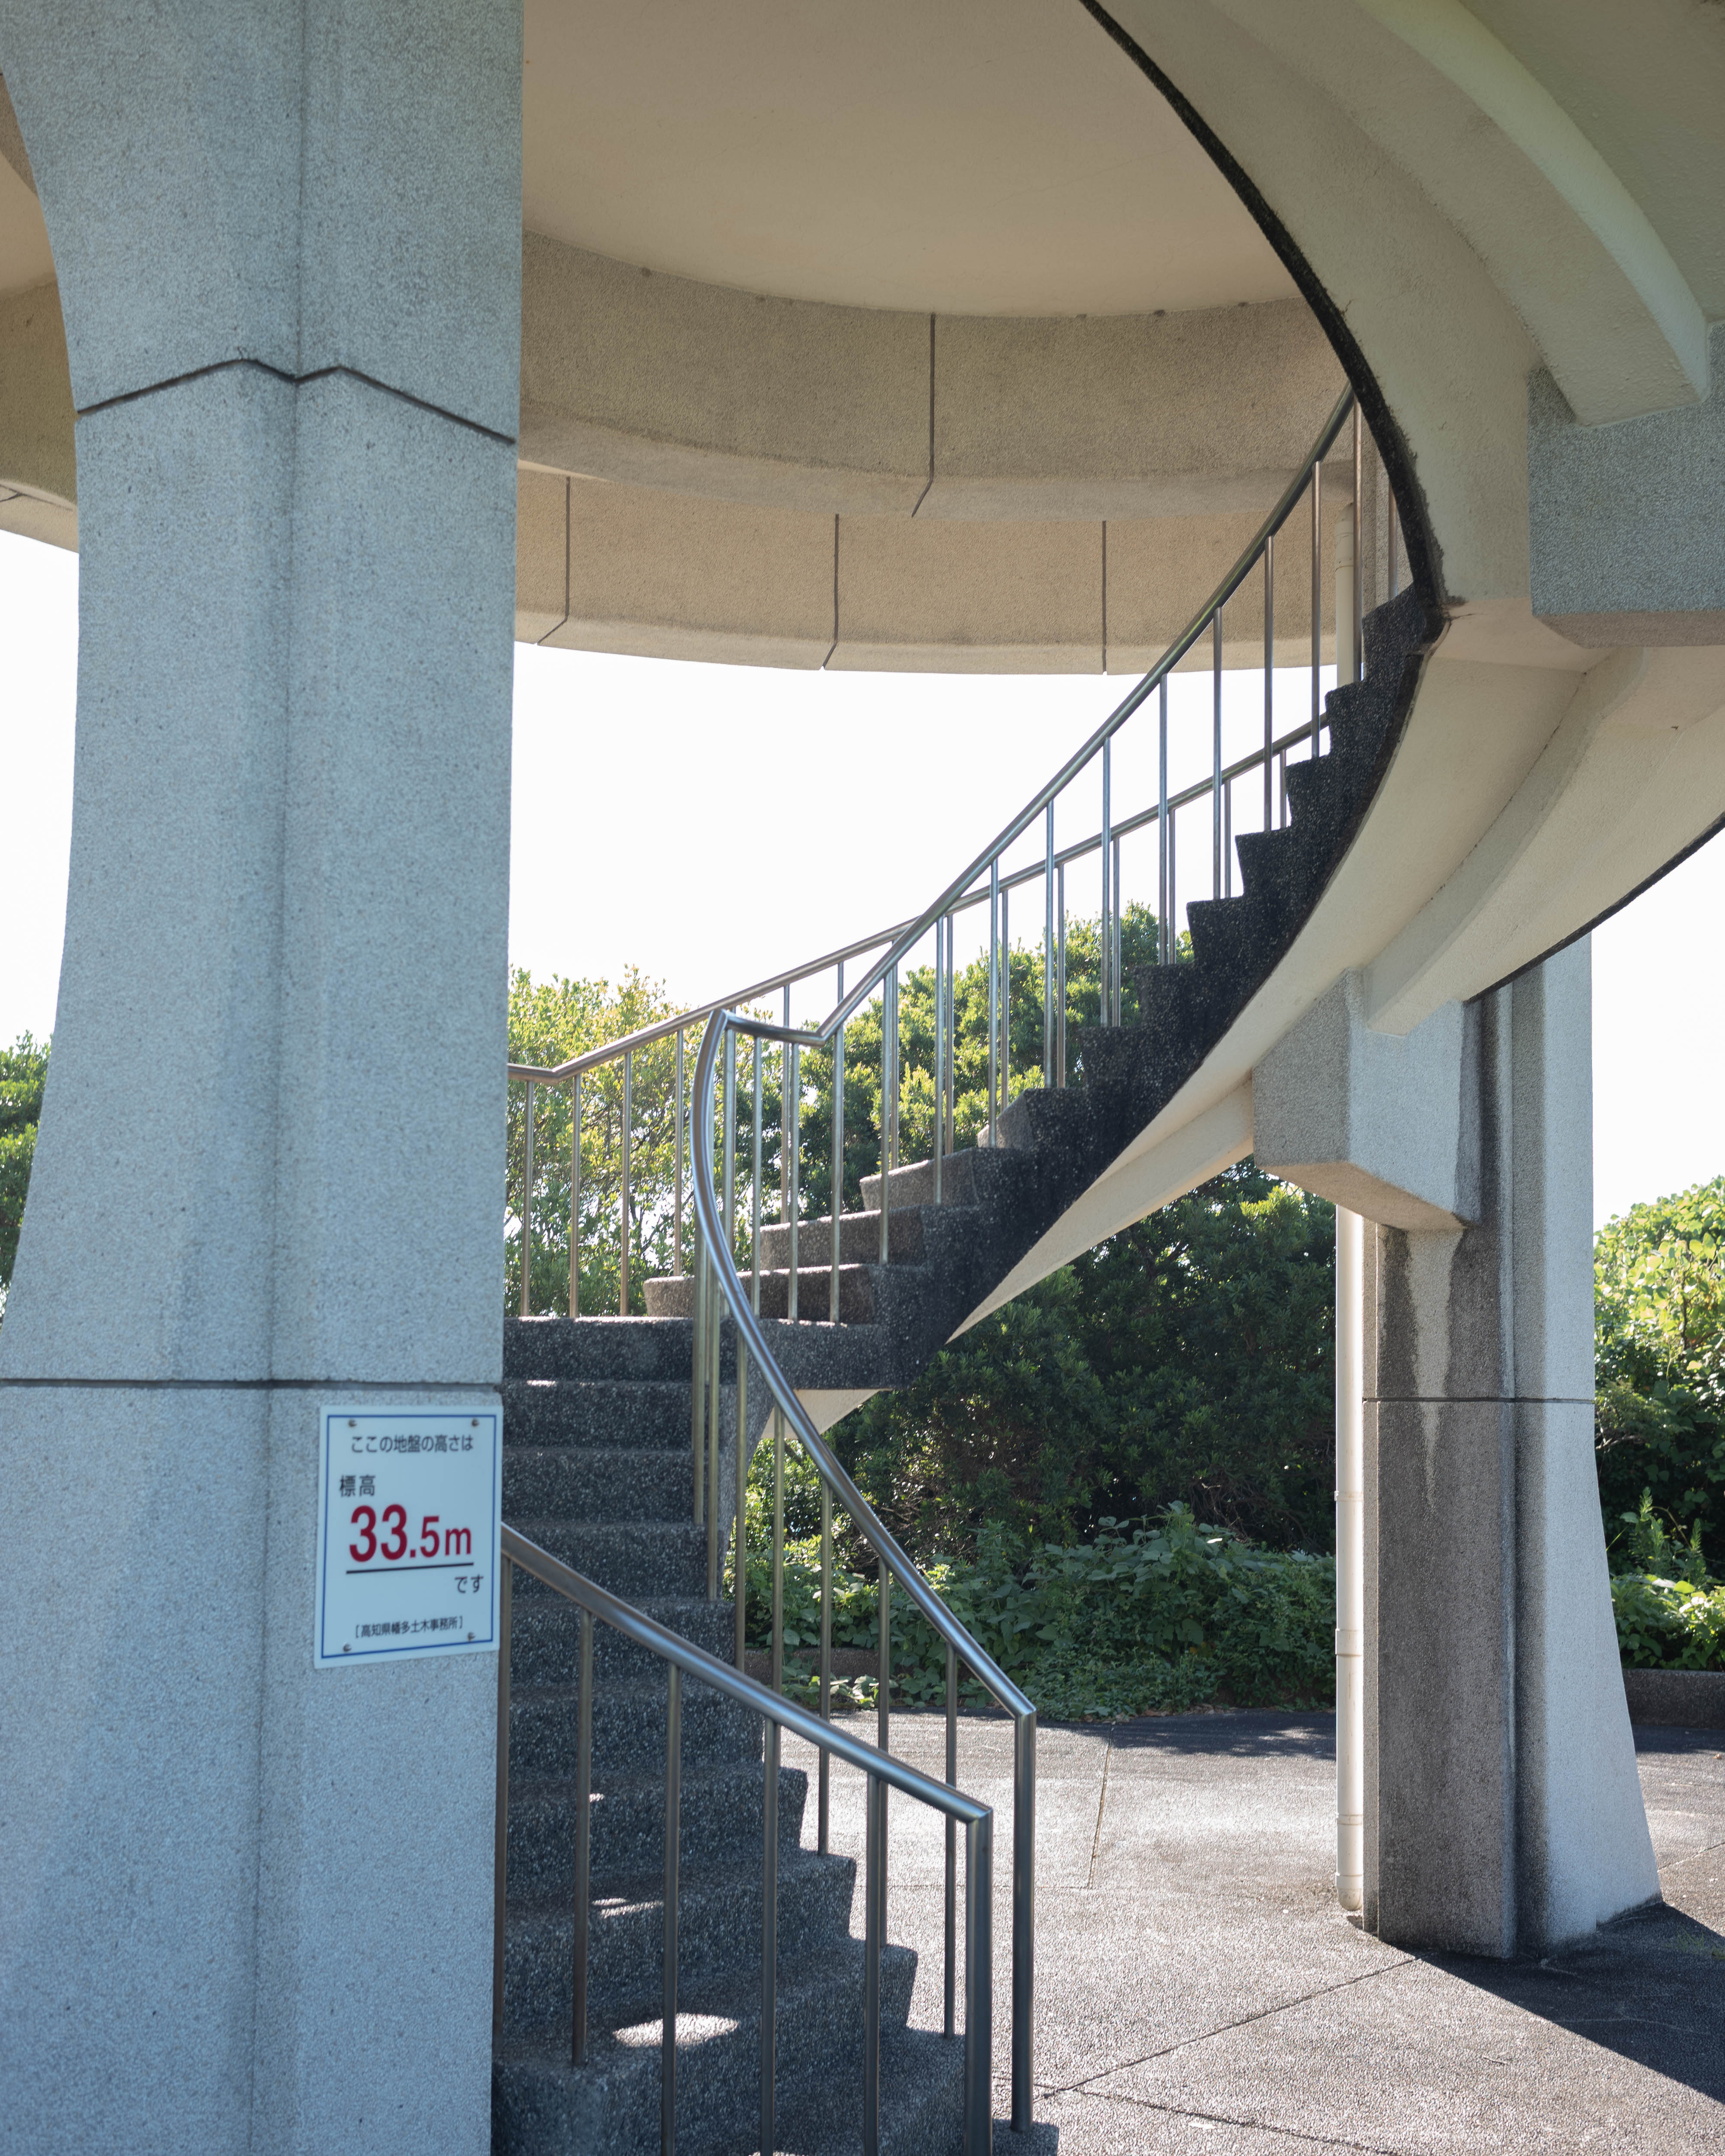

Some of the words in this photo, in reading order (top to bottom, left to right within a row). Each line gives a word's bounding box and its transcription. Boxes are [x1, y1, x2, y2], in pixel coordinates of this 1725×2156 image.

[352, 1435, 474, 1453] ここの地盤の高さは
[339, 1475, 376, 1497] 標高
[349, 1504, 472, 1562] 33.5m
[455, 1575, 484, 1593] です
